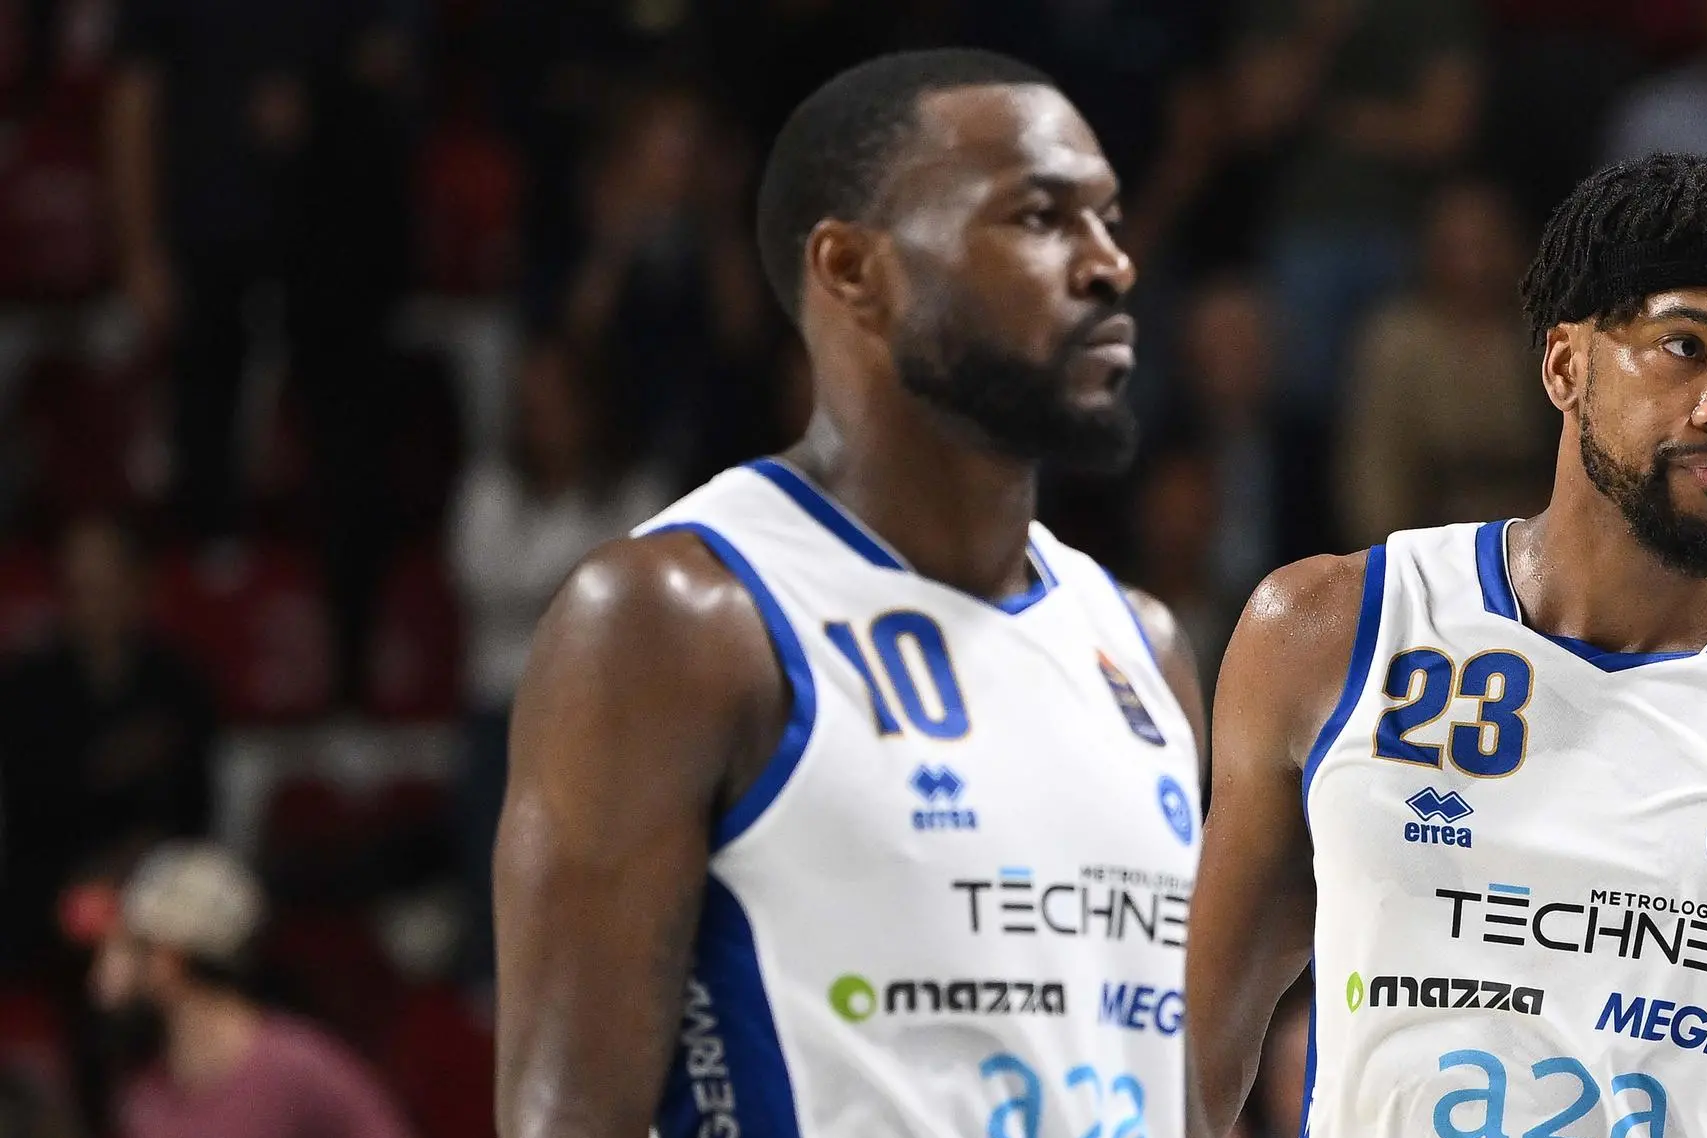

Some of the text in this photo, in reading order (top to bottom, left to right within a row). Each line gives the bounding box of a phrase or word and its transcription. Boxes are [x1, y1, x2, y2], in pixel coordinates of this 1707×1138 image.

[823, 608, 971, 741] 10
[1371, 646, 1535, 779] 23
[1404, 821, 1472, 849] errea
[884, 979, 1066, 1016] mazza
[1369, 976, 1545, 1015] mazza
